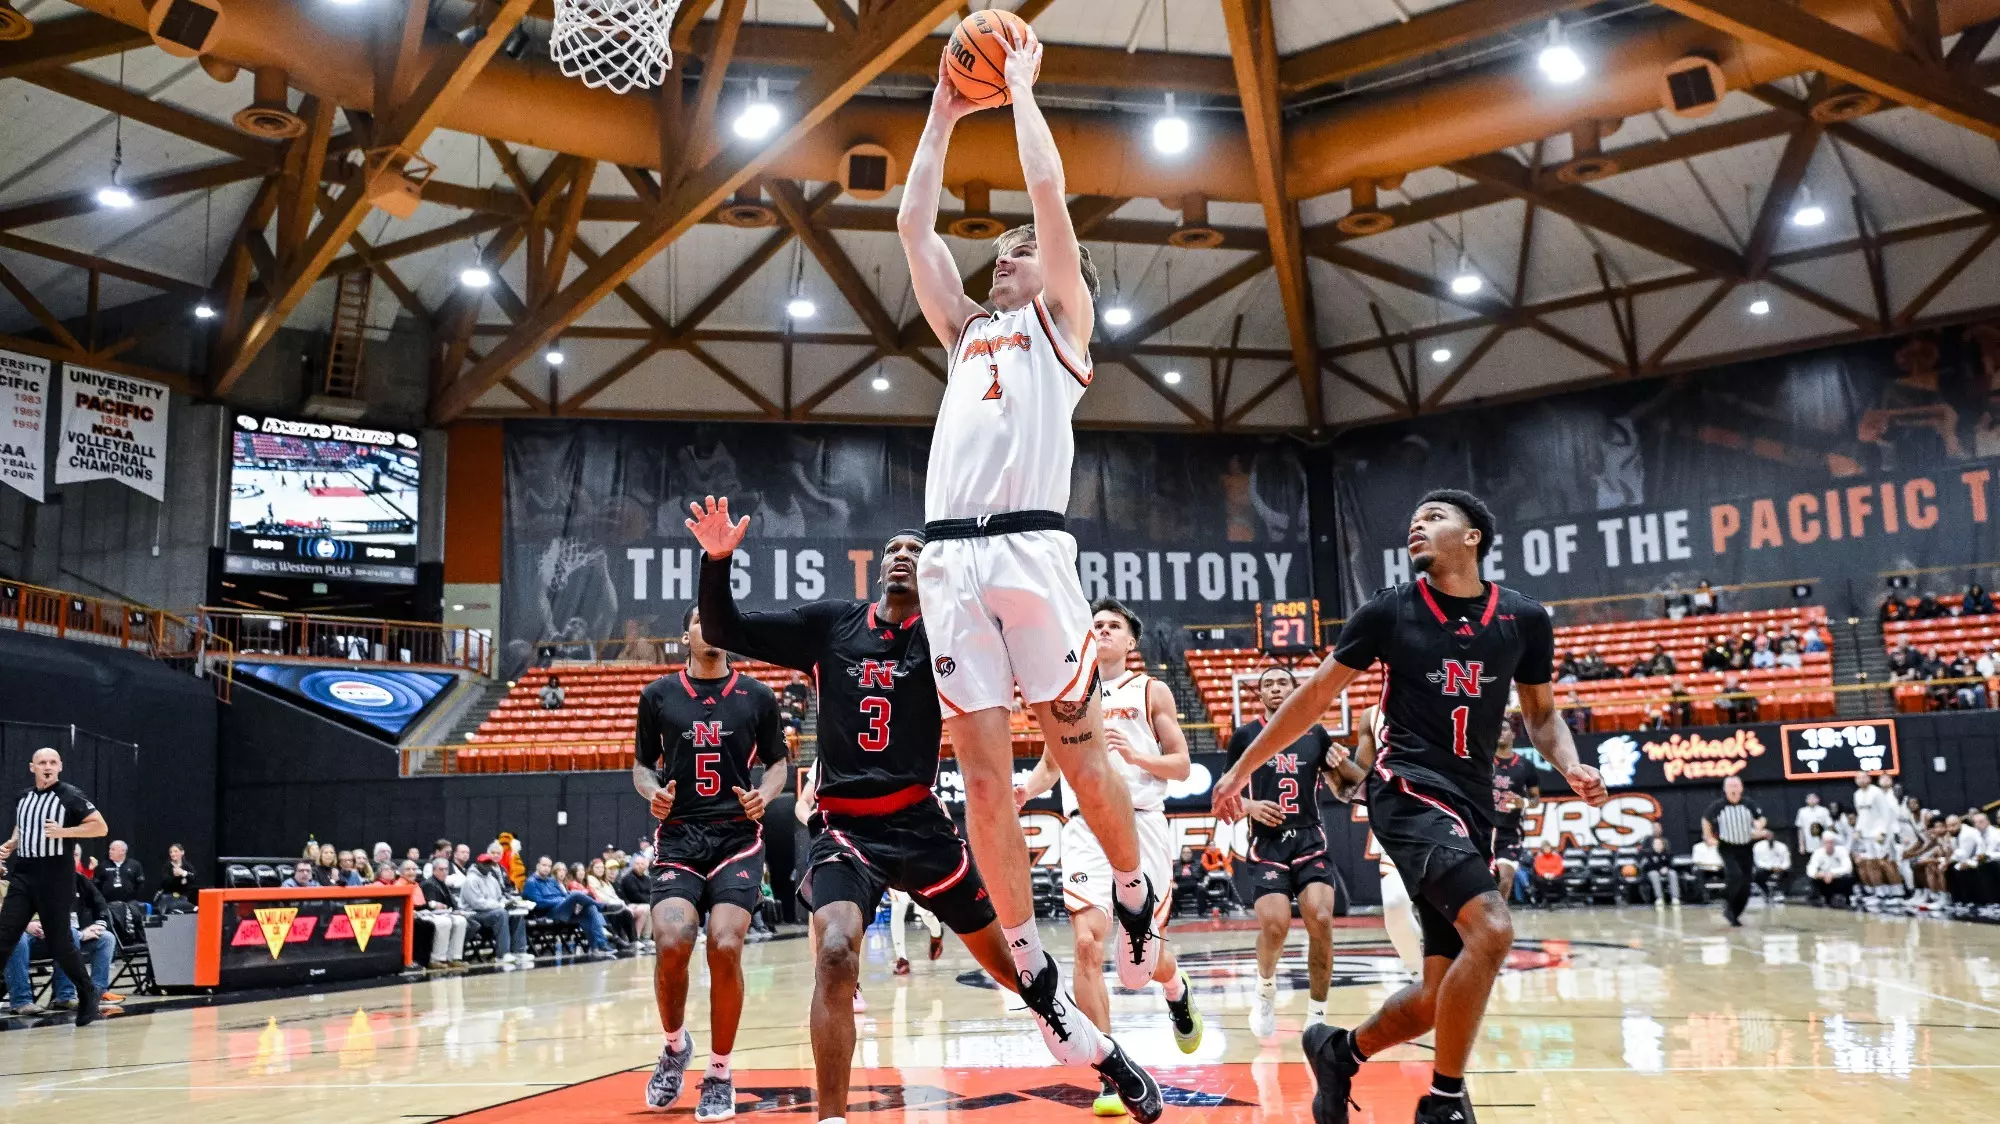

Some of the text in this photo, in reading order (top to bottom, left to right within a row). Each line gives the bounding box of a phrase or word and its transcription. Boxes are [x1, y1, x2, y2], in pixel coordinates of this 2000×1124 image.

[0, 357, 46, 374] ERSITY
[70, 370, 163, 400] UNIVERSITY
[982, 364, 1003, 400] 2
[76, 392, 153, 422] PACIFIC
[116, 393, 134, 402] THE
[68, 431, 156, 458] VOLLEYBALL
[92, 424, 134, 441] NCAA
[69, 456, 153, 481] CHAMPIONS
[76, 445, 146, 468] NATIONAL
[4, 468, 35, 481] FOUR
[1384, 534, 1505, 588] HE
[1523, 524, 1578, 577] OF
[1598, 509, 1692, 568] THE
[1710, 477, 1939, 555] PACIFIC
[252, 560, 277, 571] Best
[279, 561, 323, 575] Western
[325, 565, 352, 575] PLUS
[627, 548, 751, 601] THS
[774, 549, 825, 600] IS
[1079, 551, 1293, 601] RRITORY
[1272, 601, 1307, 617] 19:09
[1271, 618, 1306, 647] 27
[859, 658, 899, 689] N
[1442, 659, 1483, 697] N
[693, 721, 722, 747] N
[858, 696, 891, 751] 3
[1451, 706, 1471, 758] 1
[696, 753, 720, 796] 5
[1276, 754, 1298, 774] N
[1279, 778, 1299, 813] 2
